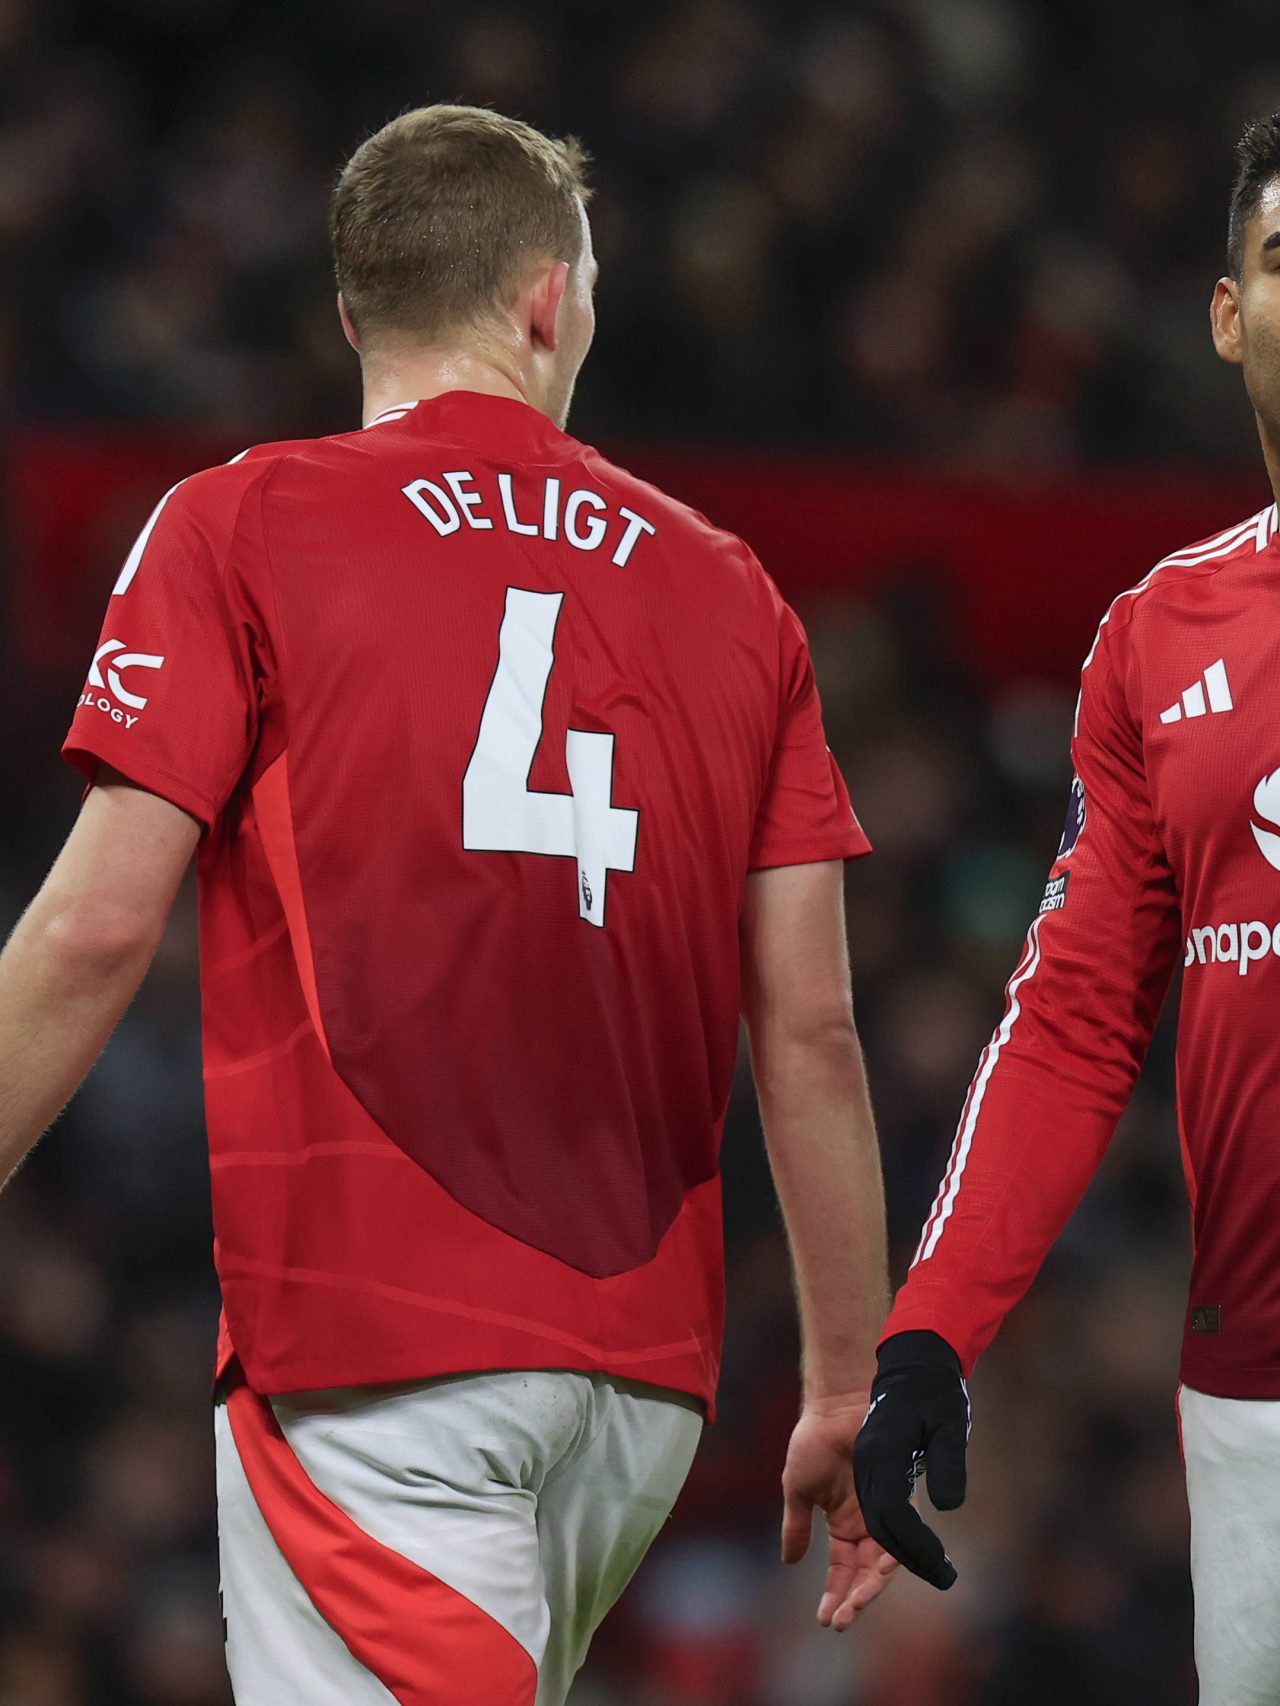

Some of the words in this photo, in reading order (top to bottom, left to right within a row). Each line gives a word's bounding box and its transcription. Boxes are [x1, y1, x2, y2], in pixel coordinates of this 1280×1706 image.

[401, 471, 494, 537] DE
[497, 473, 656, 568] LIGT
[462, 584, 640, 929] 4
